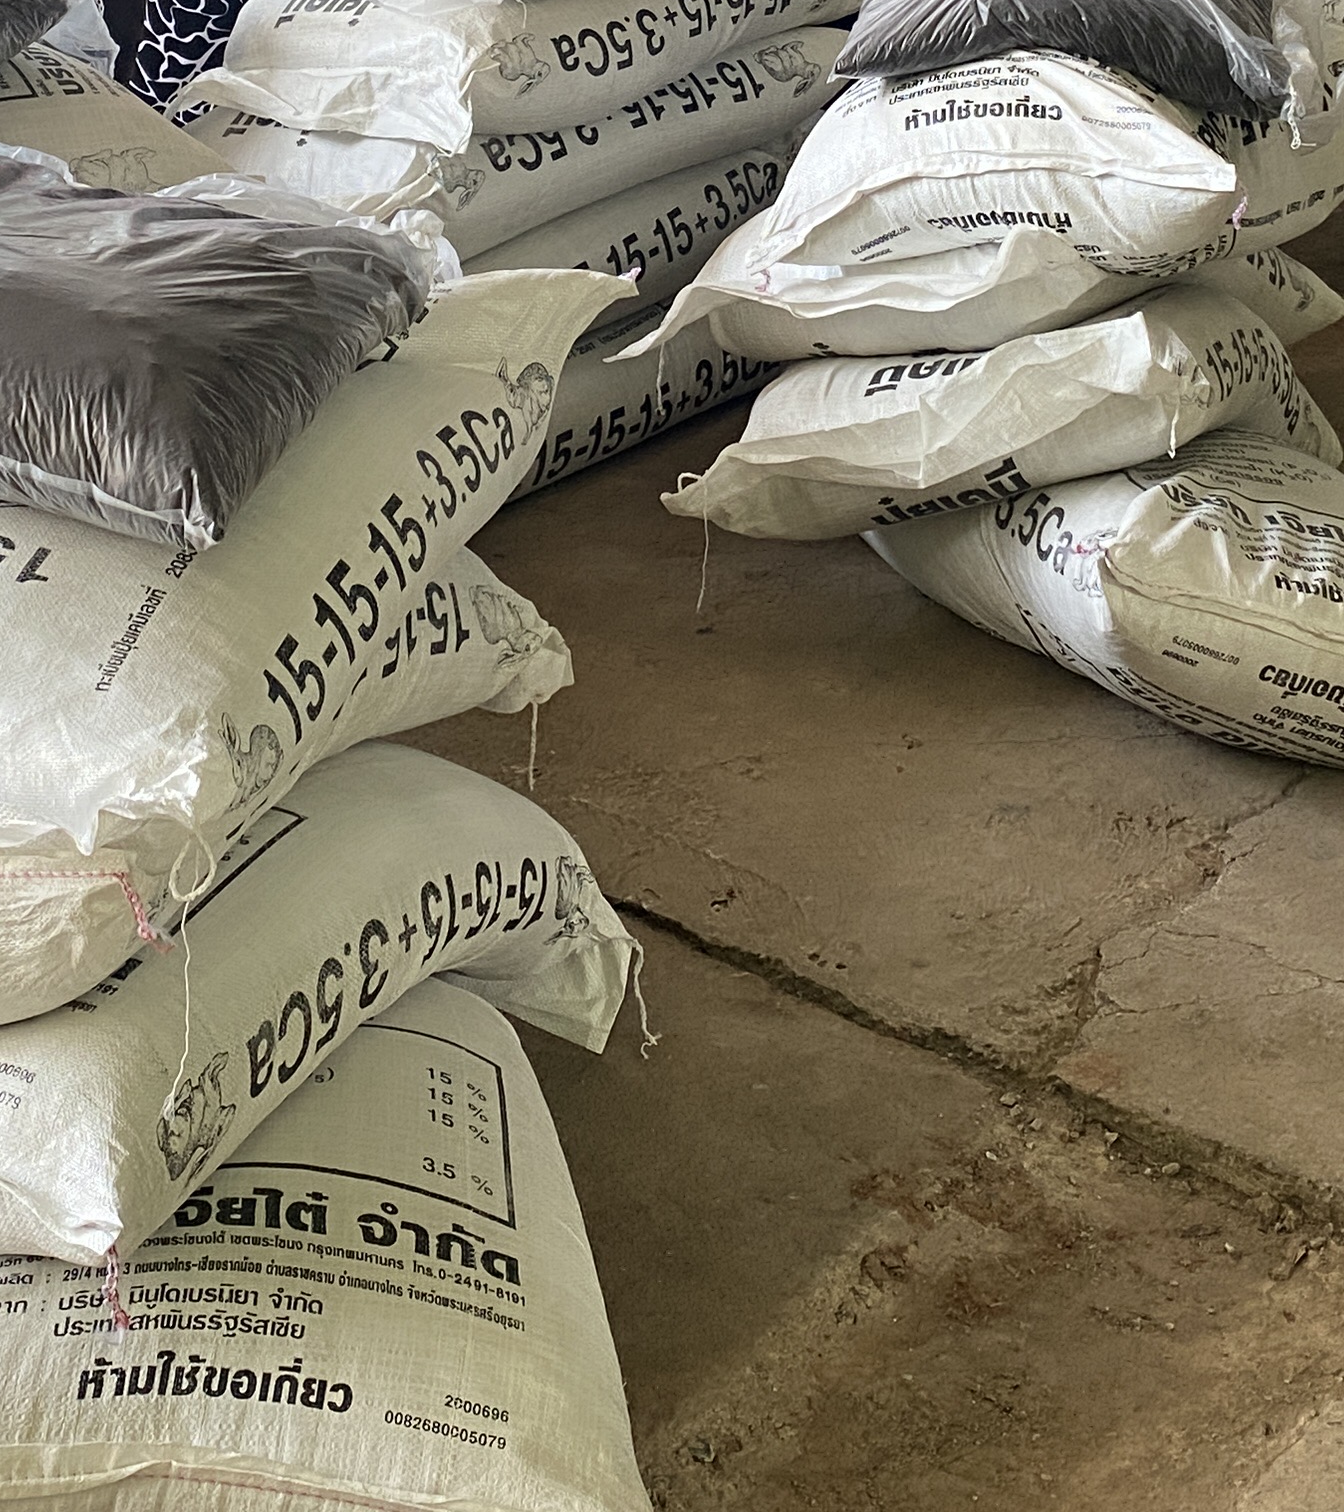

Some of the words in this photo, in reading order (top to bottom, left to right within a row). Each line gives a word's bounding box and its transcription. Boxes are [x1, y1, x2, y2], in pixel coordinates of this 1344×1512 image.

[904, 94, 1064, 132] ห้ามใช้ขอเกี่ยว
[263, 407, 515, 746] 15-15-15+3.5Ca
[244, 856, 550, 1099] 15-15-15+3.5Ca
[425, 1067, 453, 1086] 15
[466, 1082, 488, 1103] %
[427, 1087, 455, 1106] 15
[467, 1102, 489, 1124] %
[427, 1108, 455, 1128] 15
[468, 1124, 490, 1145] %
[422, 1156, 457, 1180] 3.5
[470, 1174, 494, 1197] %
[173, 1185, 330, 1236] จียไต๋
[356, 1201, 522, 1287] จำกัด
[62, 1266, 92, 1283] 29/4
[122, 1263, 131, 1276] 3
[307, 1242, 405, 1271] กรุงเทพมหานคร
[268, 1287, 324, 1316] จำกัด
[76, 1350, 354, 1414] ห้ามใช้ขอเกี่ยว
[444, 1393, 511, 1424] 2000696
[383, 1409, 508, 1451] 0082680005079
